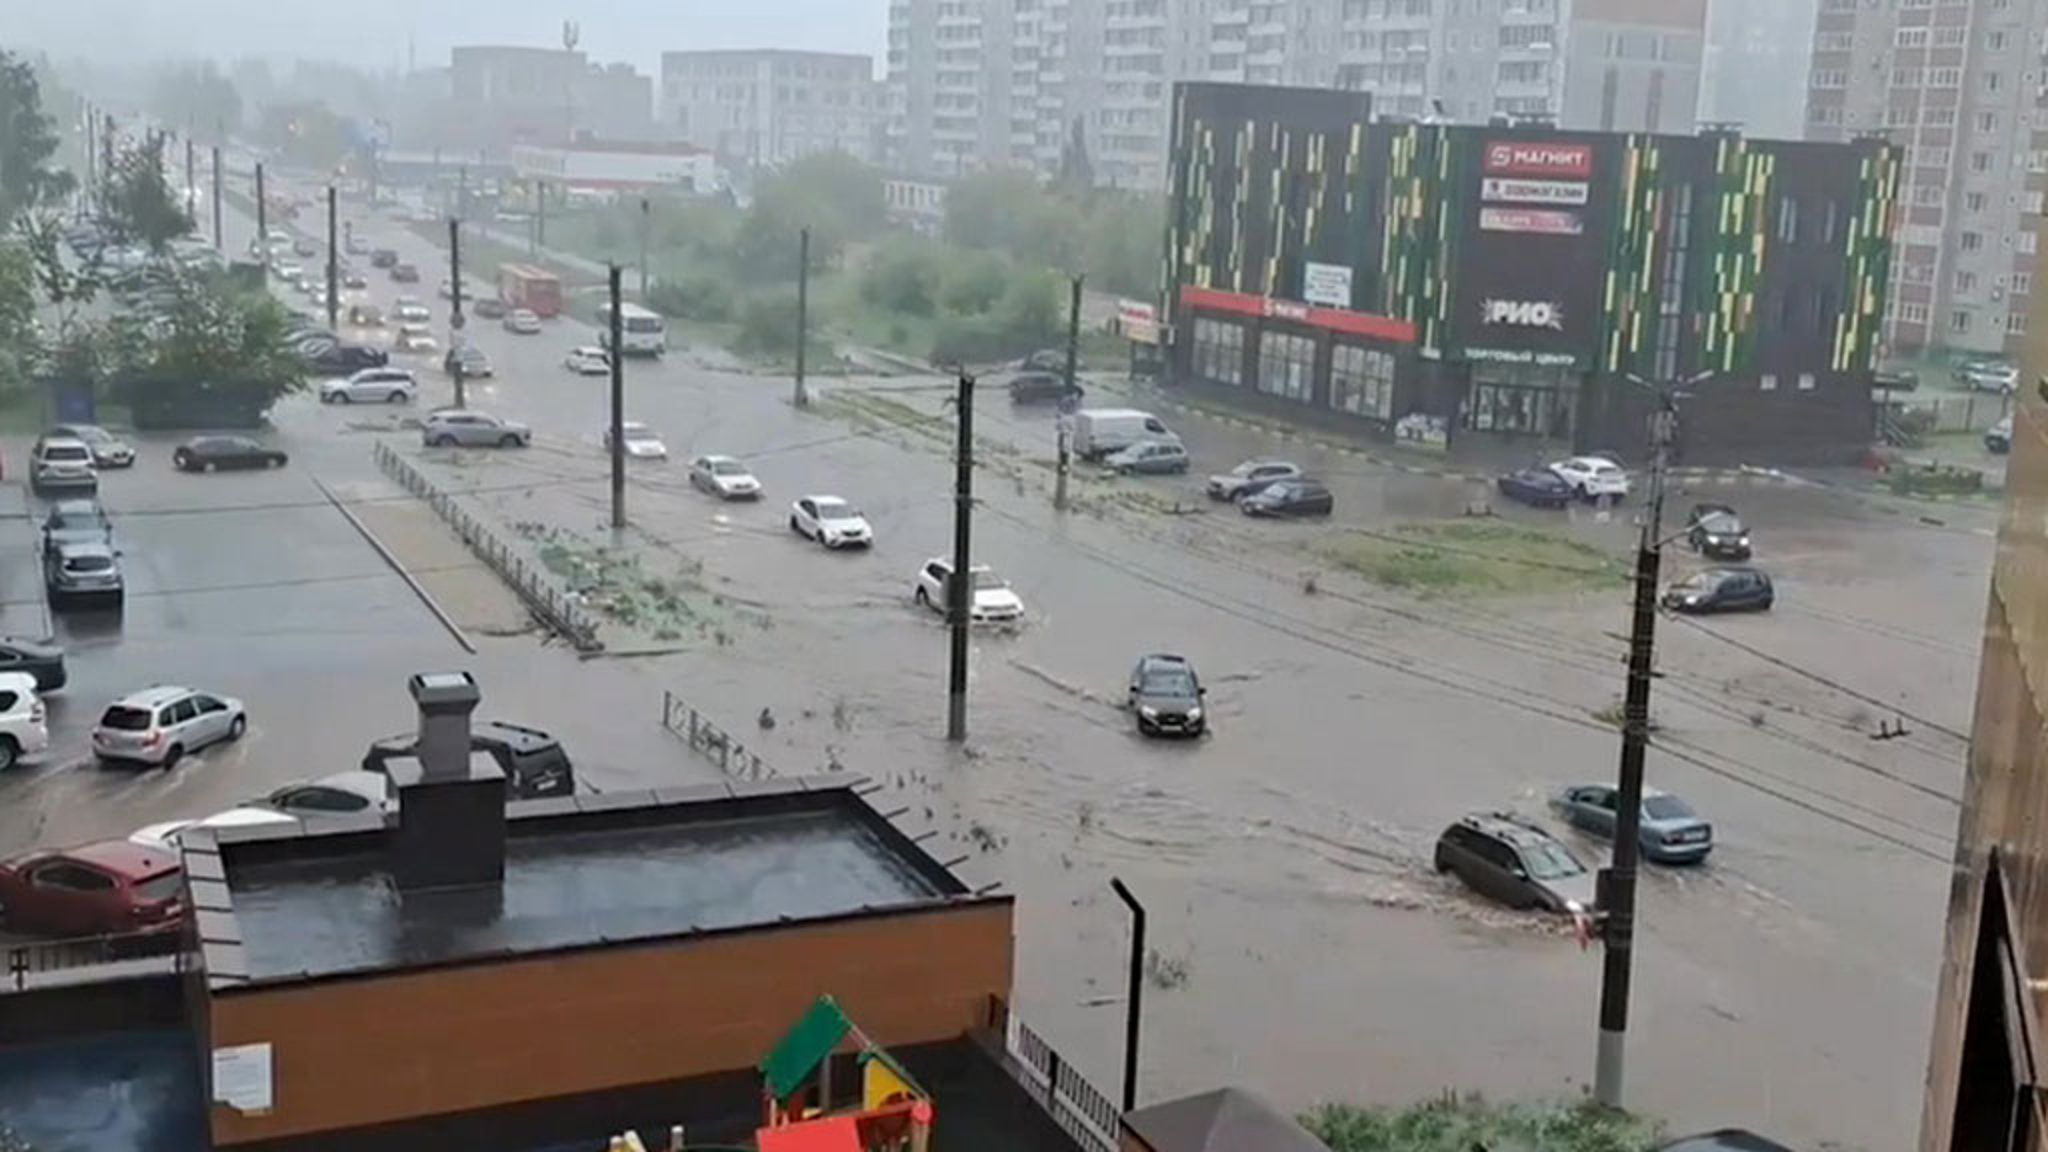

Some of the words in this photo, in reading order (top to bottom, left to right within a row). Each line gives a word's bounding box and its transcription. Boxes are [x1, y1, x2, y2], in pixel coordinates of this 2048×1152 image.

[1513, 150, 1584, 166] МАГНИТ
[1492, 300, 1551, 325] РИО
[1465, 348, 1532, 362] ТОРГОВЫЙ
[1535, 353, 1576, 365] ЦЕНТР
